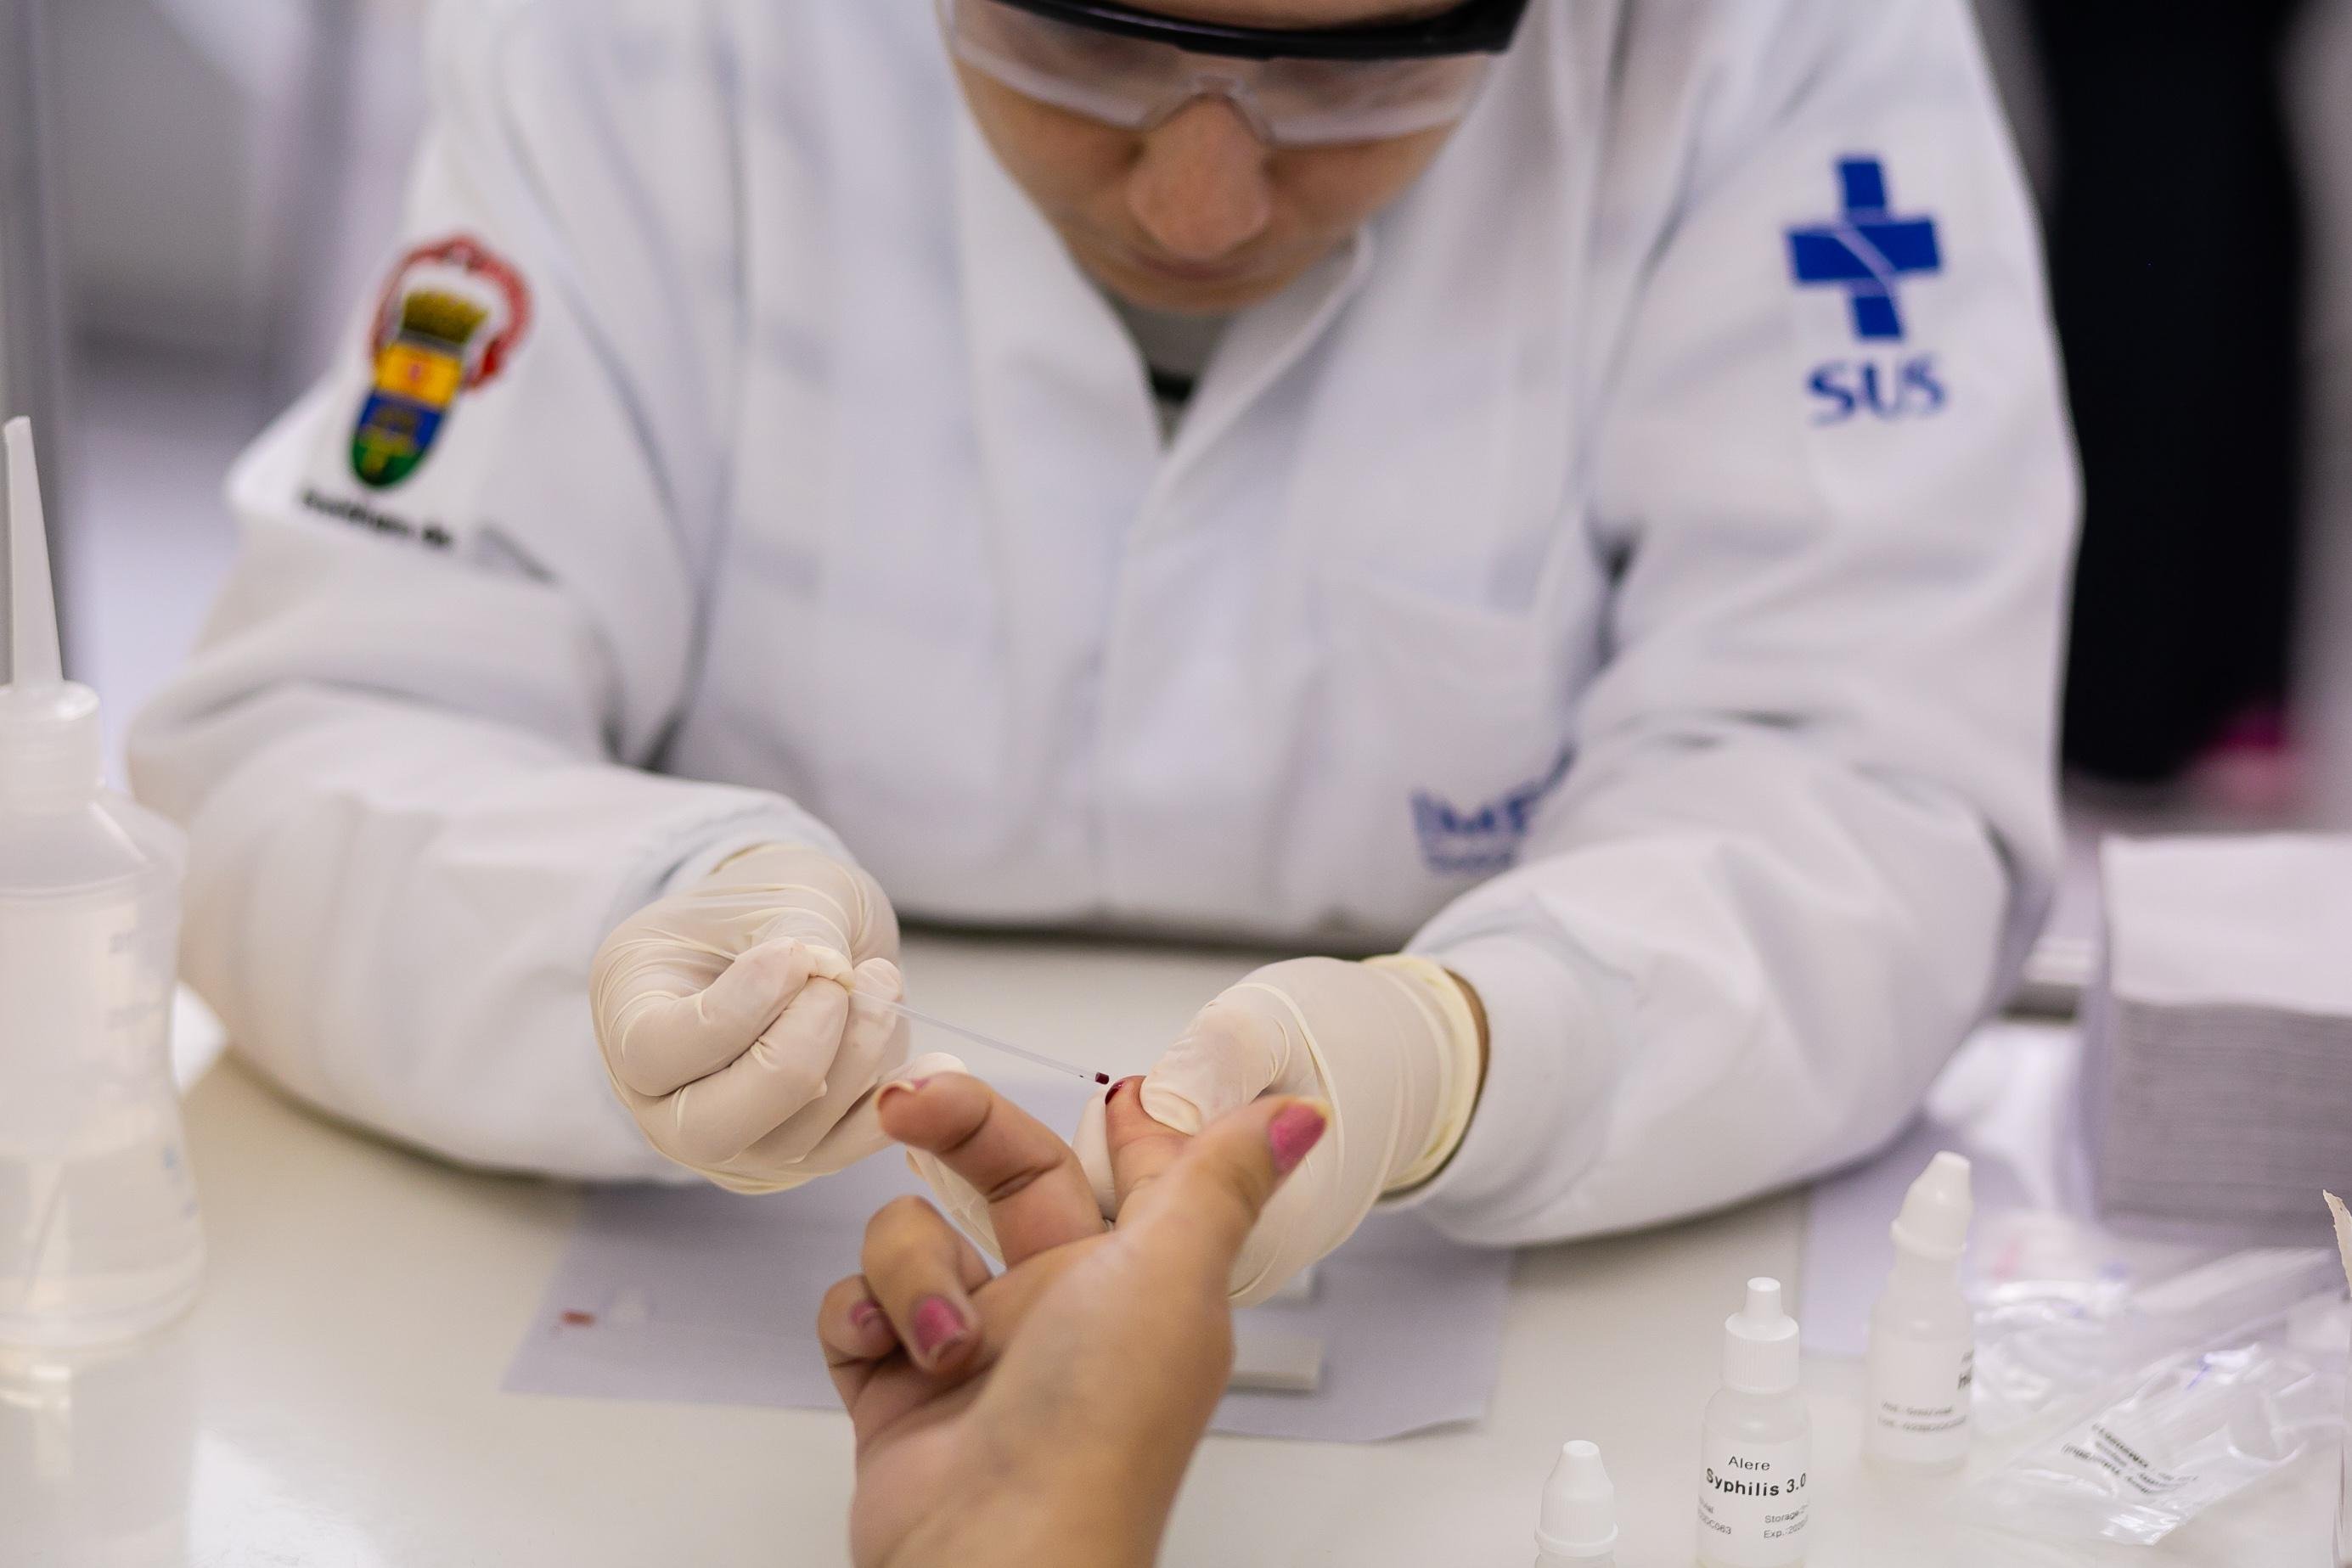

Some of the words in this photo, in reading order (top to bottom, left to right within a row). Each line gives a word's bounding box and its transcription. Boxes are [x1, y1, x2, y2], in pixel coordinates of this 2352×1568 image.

[1806, 355, 1947, 425] SUS
[1728, 1455, 1771, 1471] Alere
[1706, 1467, 1780, 1497] Syphilis
[1786, 1472, 1807, 1494] 3.0
